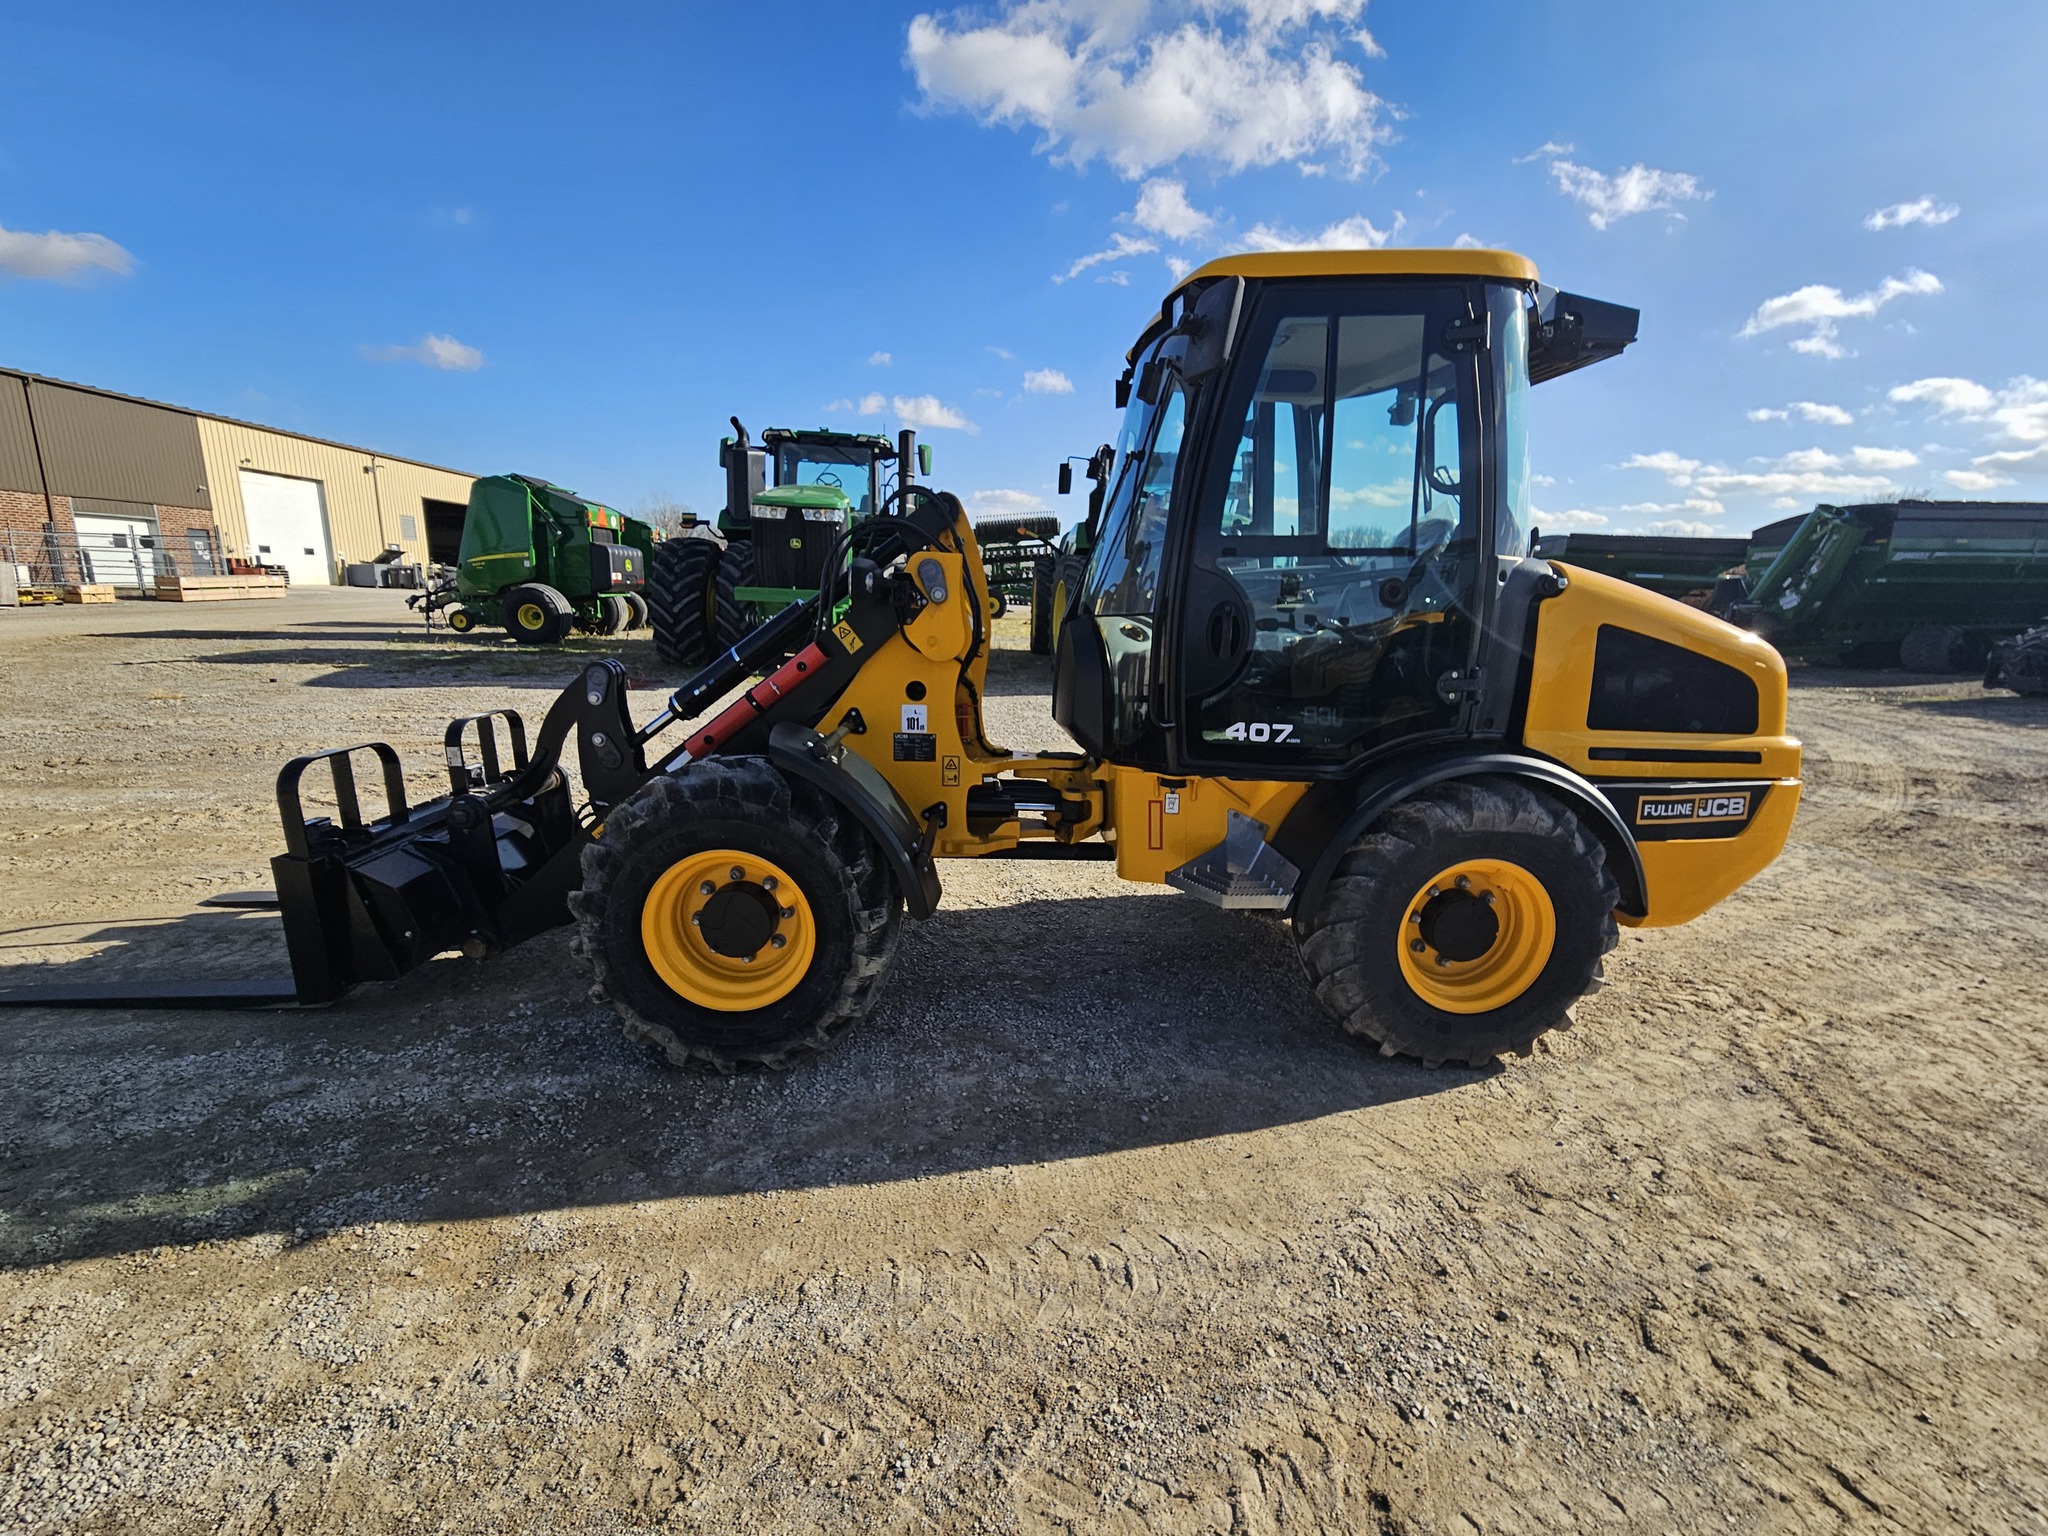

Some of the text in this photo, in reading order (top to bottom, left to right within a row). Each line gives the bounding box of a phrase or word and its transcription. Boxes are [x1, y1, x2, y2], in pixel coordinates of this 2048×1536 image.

[906, 717, 919, 730] 101
[1225, 722, 1294, 743] 407
[1644, 798, 1745, 816] FULLINE JCB
